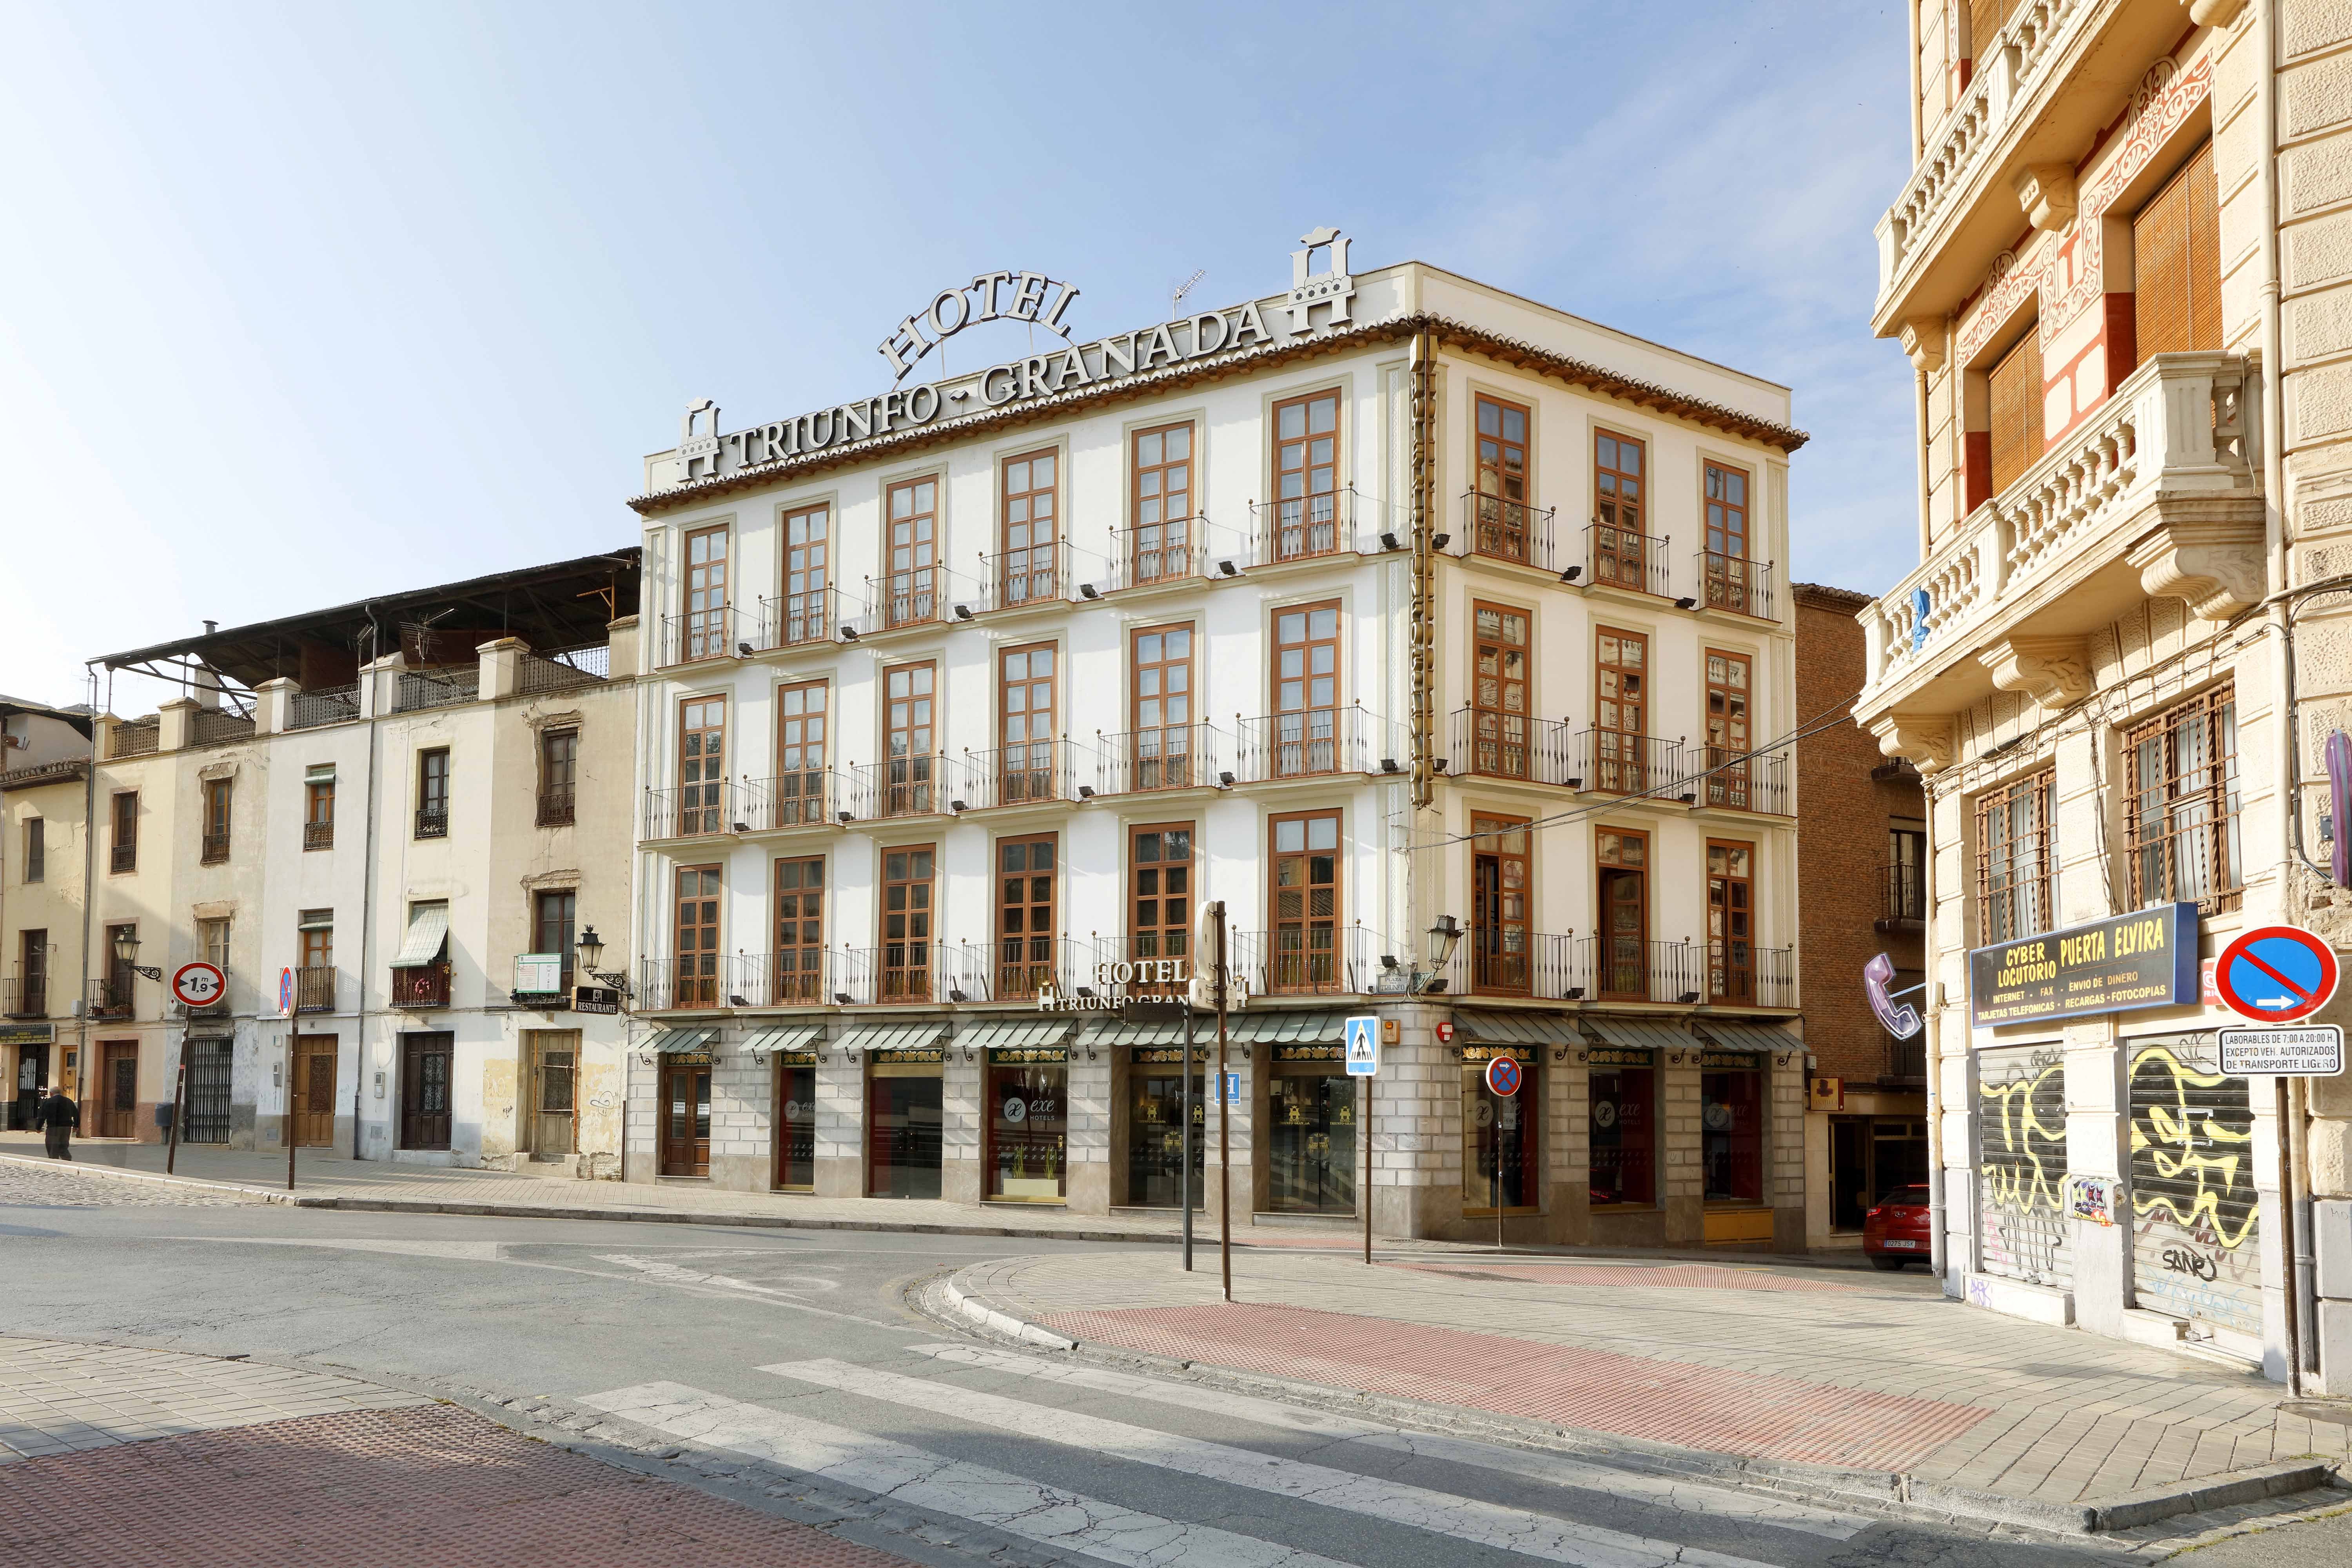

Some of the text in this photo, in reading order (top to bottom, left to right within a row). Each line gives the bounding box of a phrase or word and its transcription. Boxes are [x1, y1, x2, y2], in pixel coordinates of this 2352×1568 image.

[877, 270, 1080, 380] HOTEL
[729, 383, 942, 468] TRIUNFO
[978, 300, 1273, 408] GRANADA
[2006, 918, 2164, 967] CYBER PUERTA ELVIRA
[1092, 959, 1188, 985] HOTEL
[1998, 960, 2056, 988] LOCUTORIO
[1993, 991, 2025, 1004] INTERNET
[2040, 986, 2053, 997] FAX
[2069, 979, 2091, 992] ENVIO
[2093, 977, 2103, 988] DE
[2107, 971, 2138, 985] DINERO
[578, 1002, 616, 1013] RESTAURANTE
[1978, 1008, 2007, 1021] TARJETAS
[2009, 1001, 2054, 1016] TELEFONICAS
[2065, 993, 2105, 1008] RECARGAS
[2111, 985, 2166, 1002] FOTOCOPIAS
[2225, 1033, 2335, 1044] LABORABLES DE 7:00 A 20:00 H.
[2226, 1046, 2335, 1057] EXCEPTO VEH. AUTORIZADOS
[2226, 1059, 2336, 1069] DE TRANSPORTE LIGERO
[1030, 1100, 1054, 1112] exe
